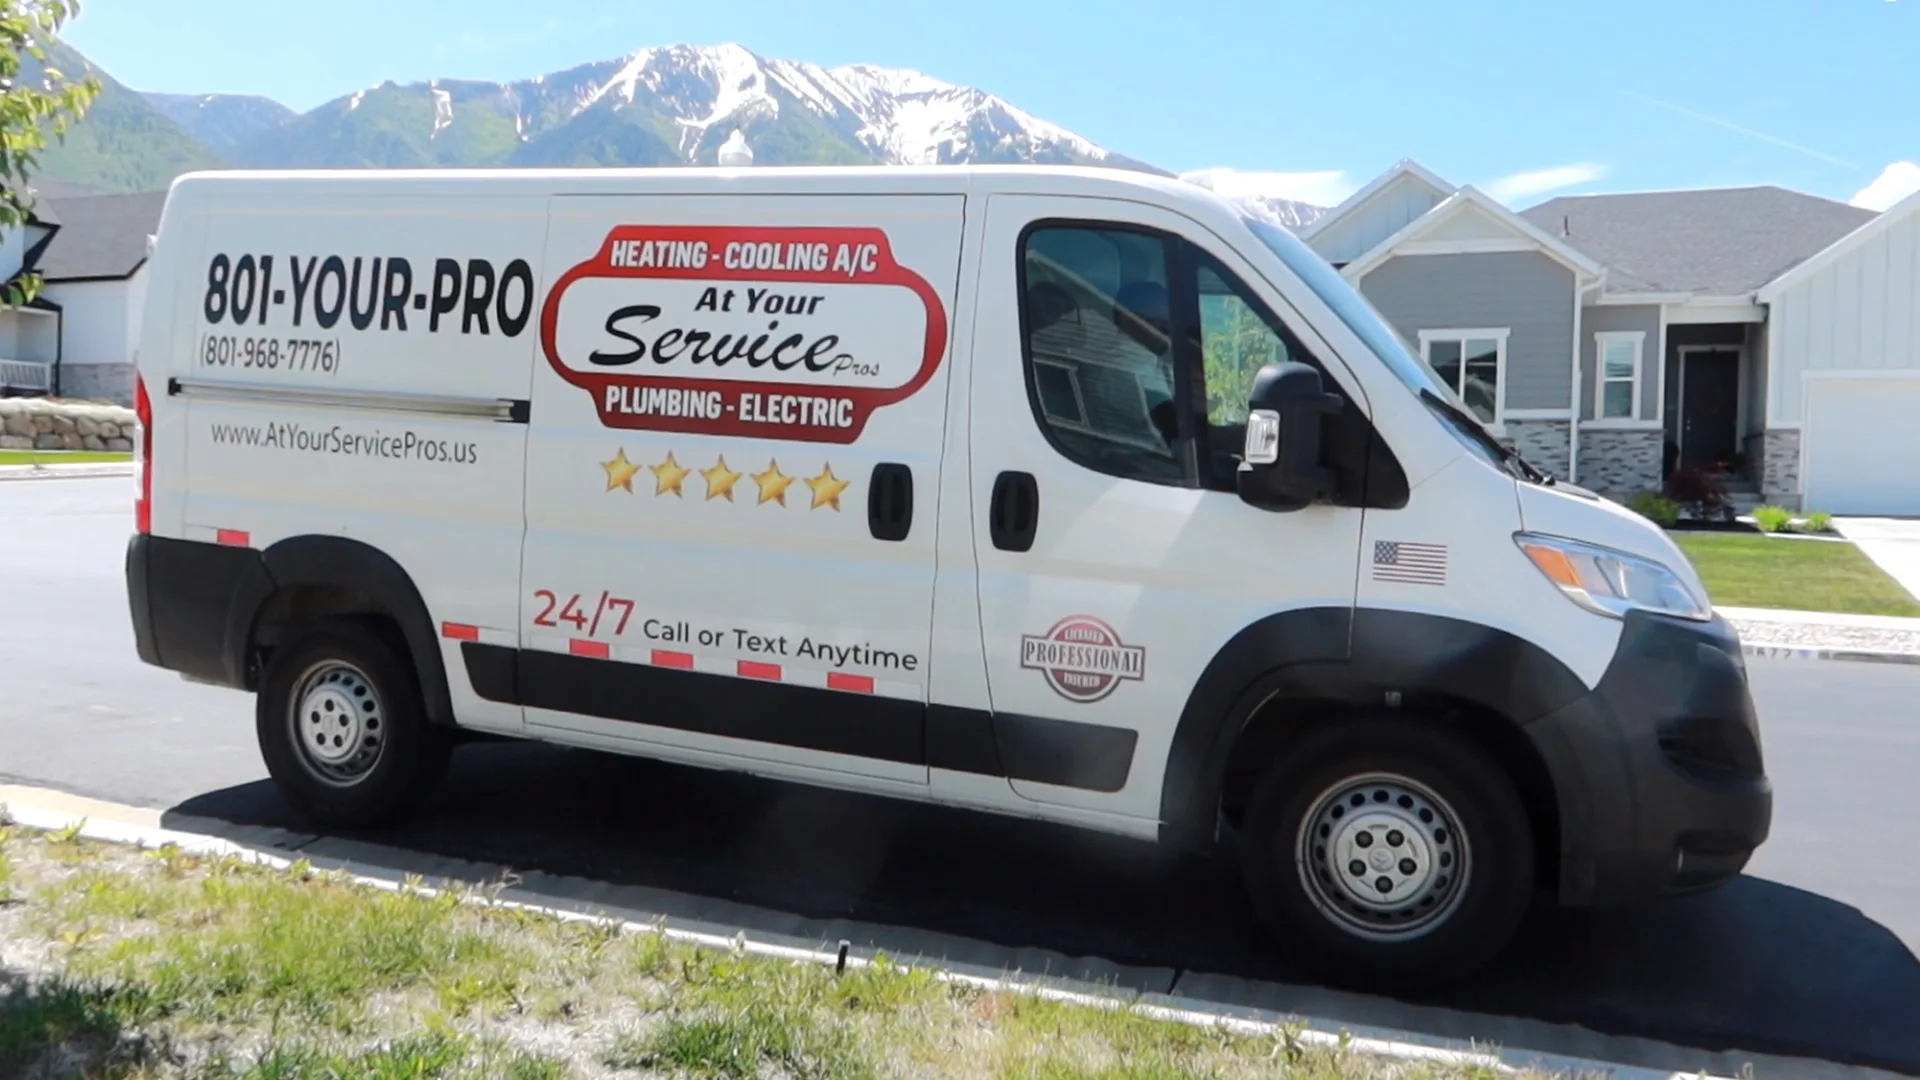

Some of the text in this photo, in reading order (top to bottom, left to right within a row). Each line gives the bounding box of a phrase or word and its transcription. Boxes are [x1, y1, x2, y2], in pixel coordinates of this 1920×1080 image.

[610, 240, 708, 270] HEATING
[724, 242, 827, 272] COOLING
[832, 243, 878, 277] A/C
[204, 253, 534, 337] 801-YOUR-PRO
[694, 287, 825, 315] At Your
[201, 337, 340, 375] (801-968-7776)
[589, 305, 880, 377] Service Pros
[605, 385, 721, 420] PLUMBING
[739, 393, 853, 428] ELECTRIC
[211, 422, 477, 464] www.AtYourServicePros.us
[533, 589, 918, 671] 24/7 Call or Text Anytime
[1025, 640, 1140, 673] PROFESSIONAL
